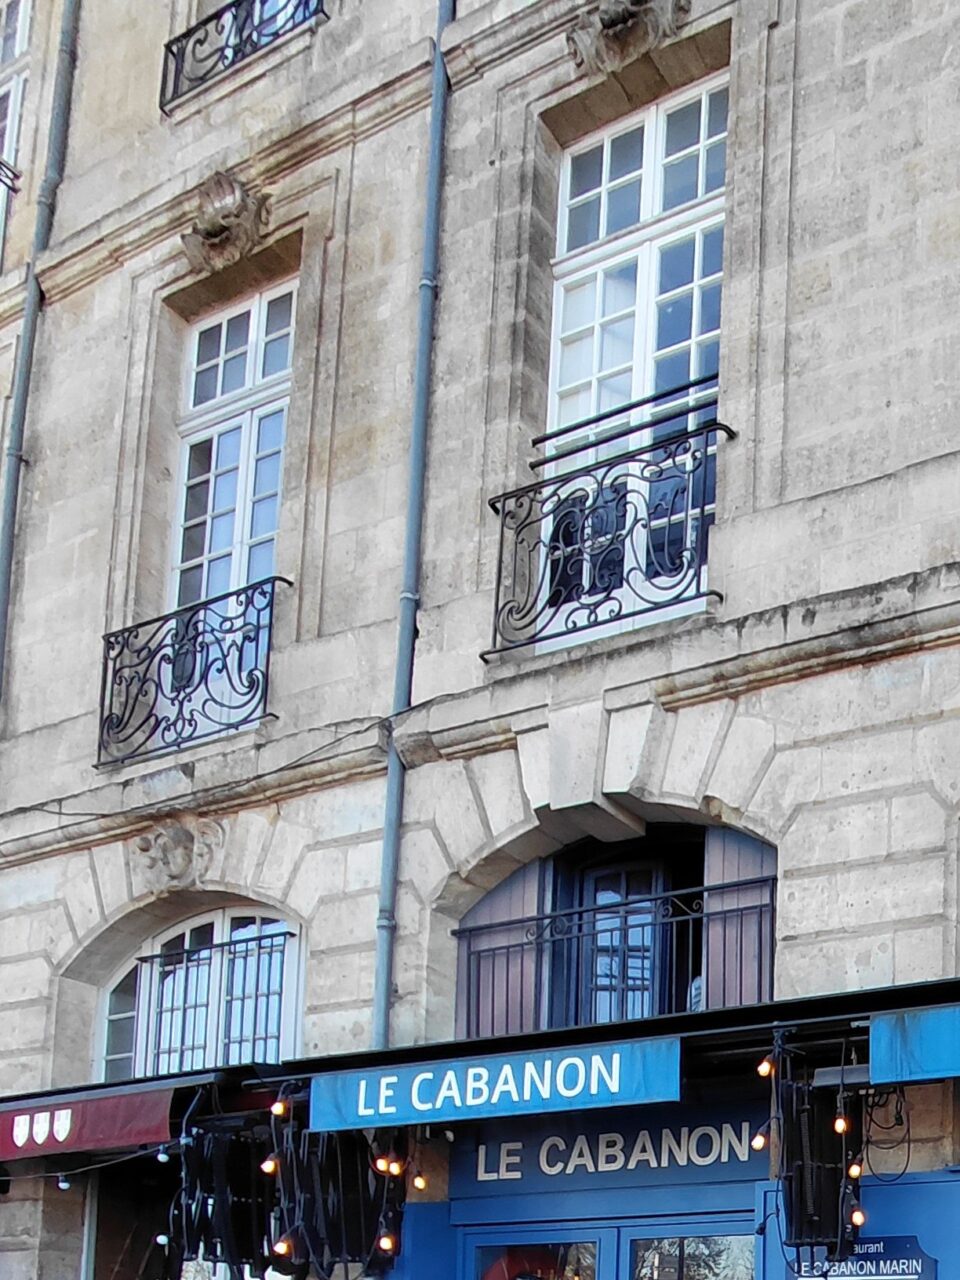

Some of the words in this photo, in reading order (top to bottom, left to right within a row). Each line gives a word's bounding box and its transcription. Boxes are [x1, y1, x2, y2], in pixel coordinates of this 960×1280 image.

[357, 1076, 399, 1116] LE
[411, 1052, 621, 1111] CABANON
[476, 1141, 523, 1181] LE
[538, 1121, 752, 1176] CABANON
[853, 1241, 884, 1255] aurant
[879, 1258, 922, 1275] MARIN
